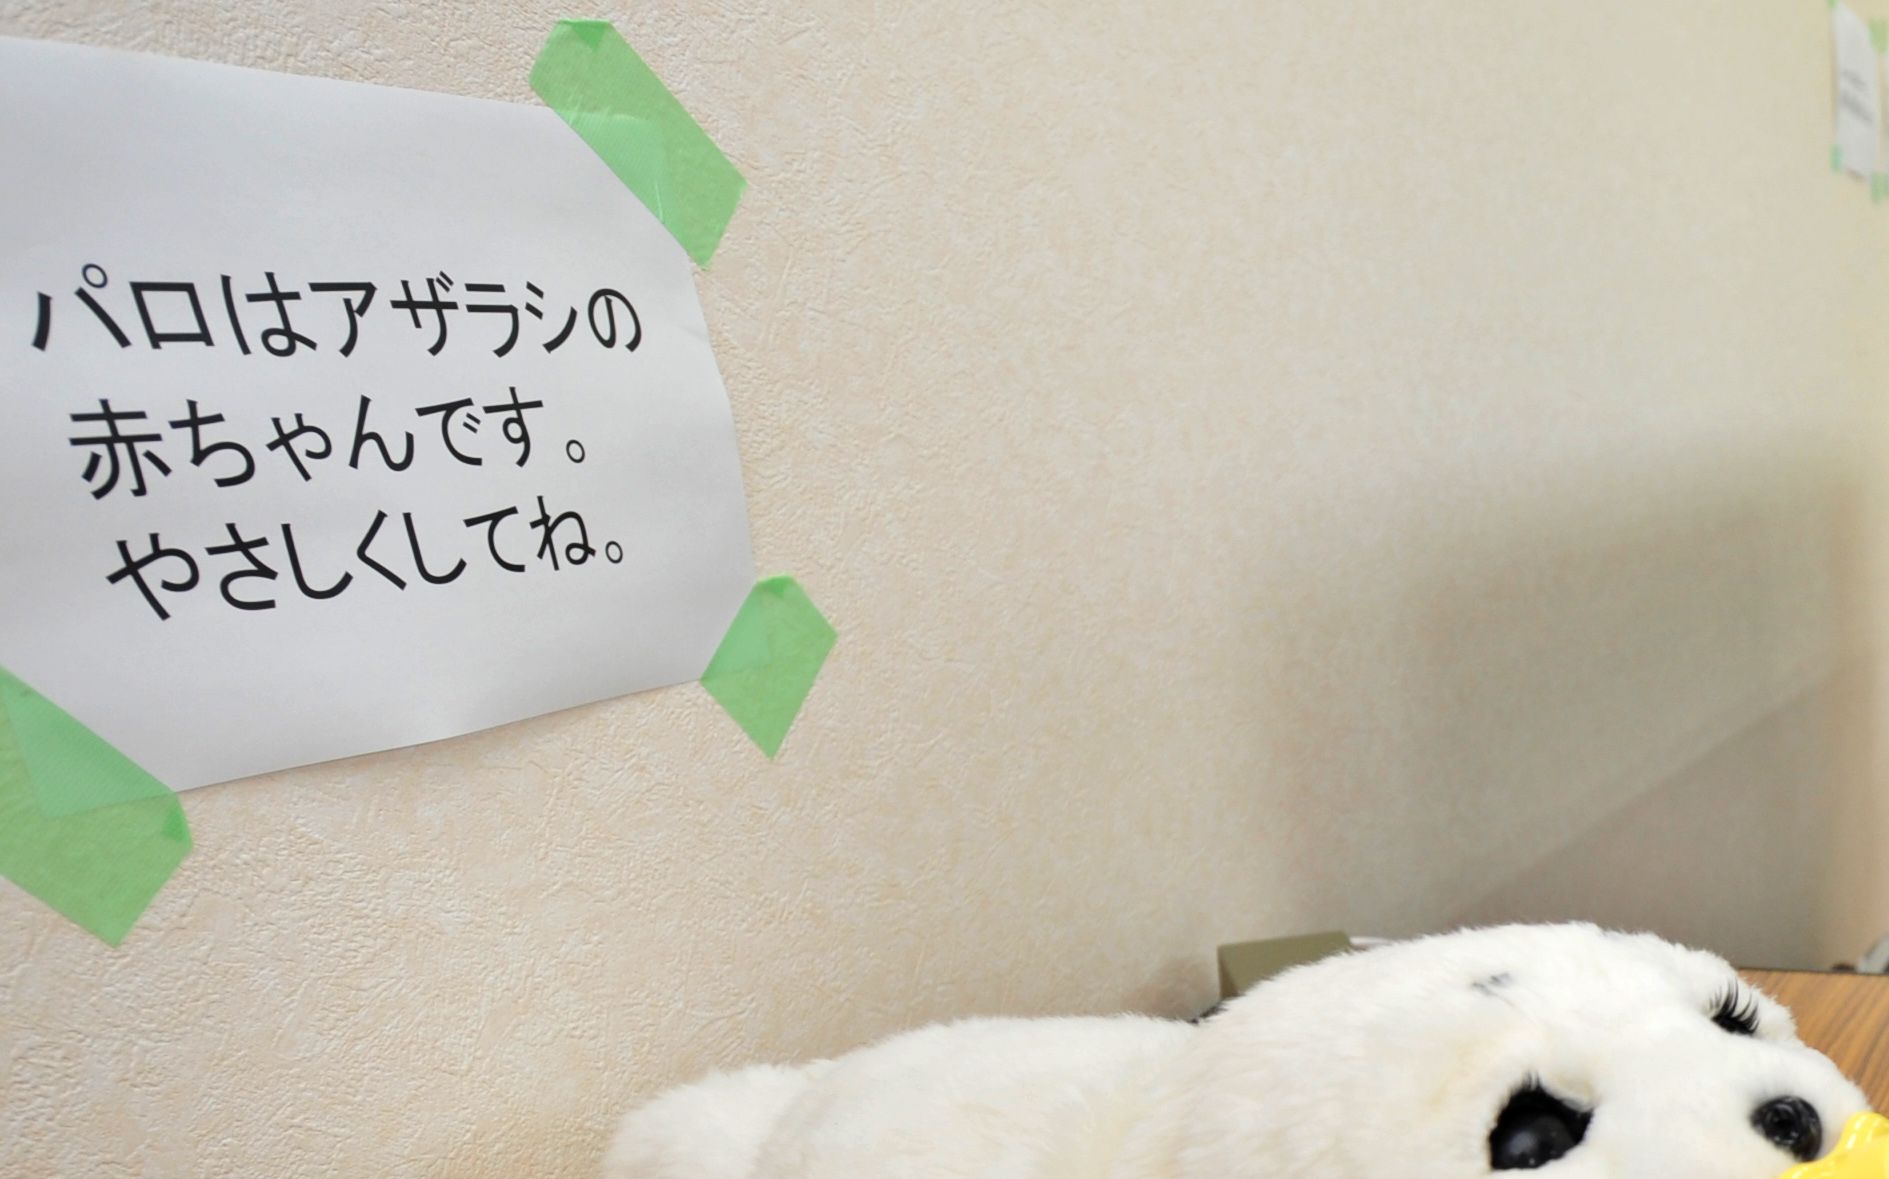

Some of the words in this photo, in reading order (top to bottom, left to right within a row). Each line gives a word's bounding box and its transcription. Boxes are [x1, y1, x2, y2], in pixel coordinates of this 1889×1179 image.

[32, 263, 642, 358] パロはアザラシの
[69, 386, 587, 500] 赤ちゃんです。
[106, 495, 623, 621] やさしくしてね。
